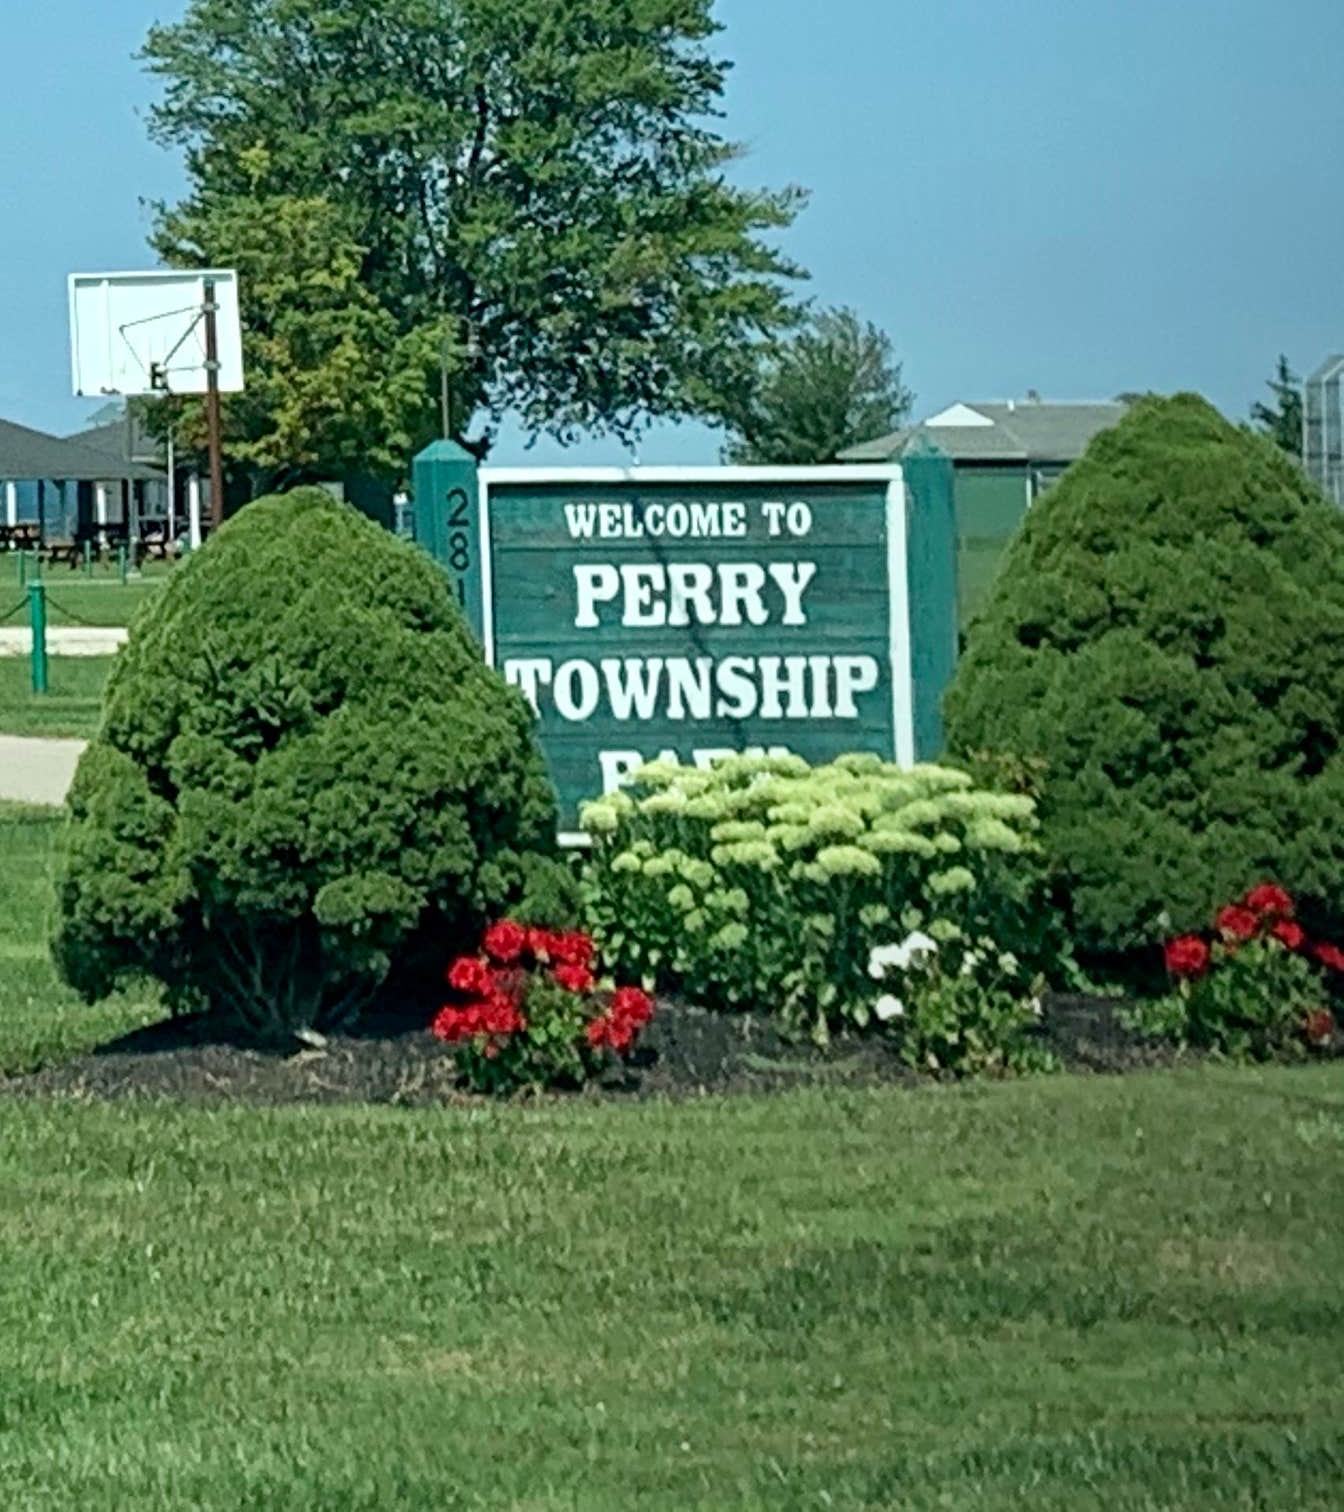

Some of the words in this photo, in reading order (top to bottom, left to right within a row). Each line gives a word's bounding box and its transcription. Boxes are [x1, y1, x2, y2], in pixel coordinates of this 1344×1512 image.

[564, 503, 746, 538] WELCOME
[762, 502, 812, 536] TO
[572, 562, 816, 628] PERRY
[504, 656, 879, 721] TOWNSHIP
